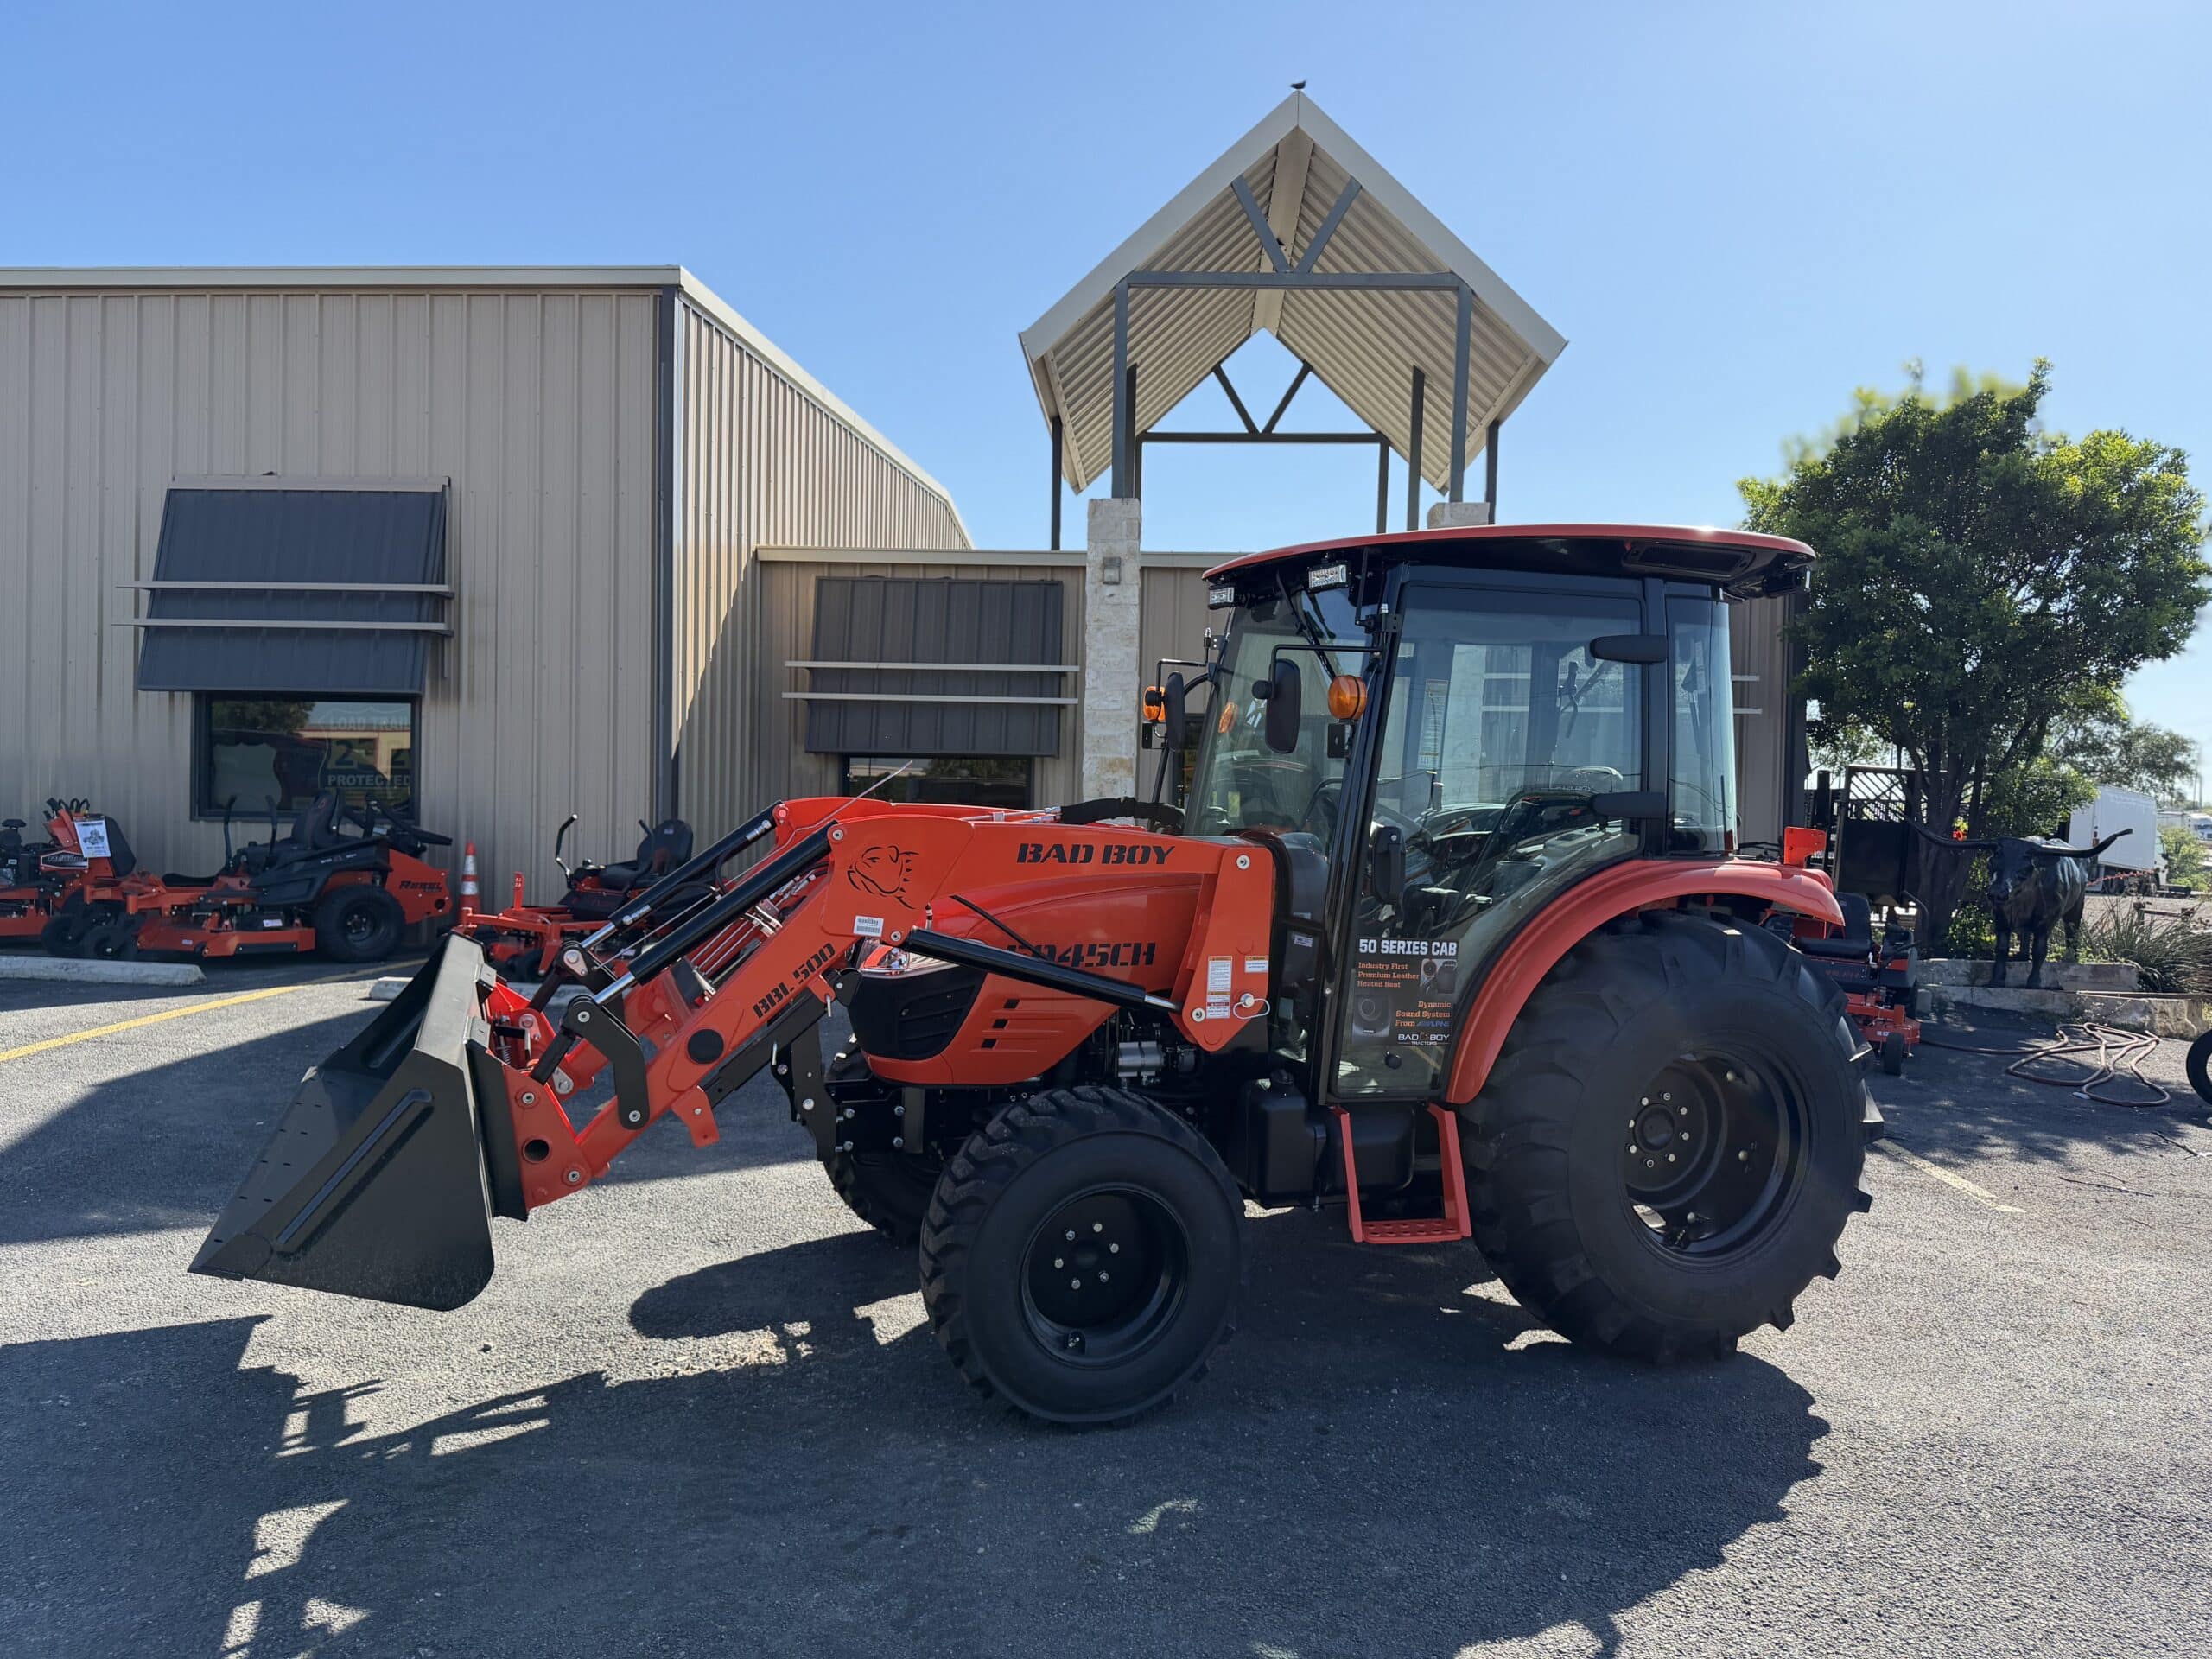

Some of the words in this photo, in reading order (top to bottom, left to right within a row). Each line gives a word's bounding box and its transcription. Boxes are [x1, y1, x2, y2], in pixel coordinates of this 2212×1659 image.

[1017, 842, 1094, 864] BAD
[1102, 844, 1175, 865] BOY
[1359, 938, 1377, 953] 50
[1381, 940, 1428, 955] SERIES
[1432, 942, 1458, 956] CAB
[792, 943, 836, 984] 500
[1357, 962, 1389, 970] Industry
[1418, 1001, 1452, 1009] Dynamic
[1422, 1010, 1451, 1019] System
